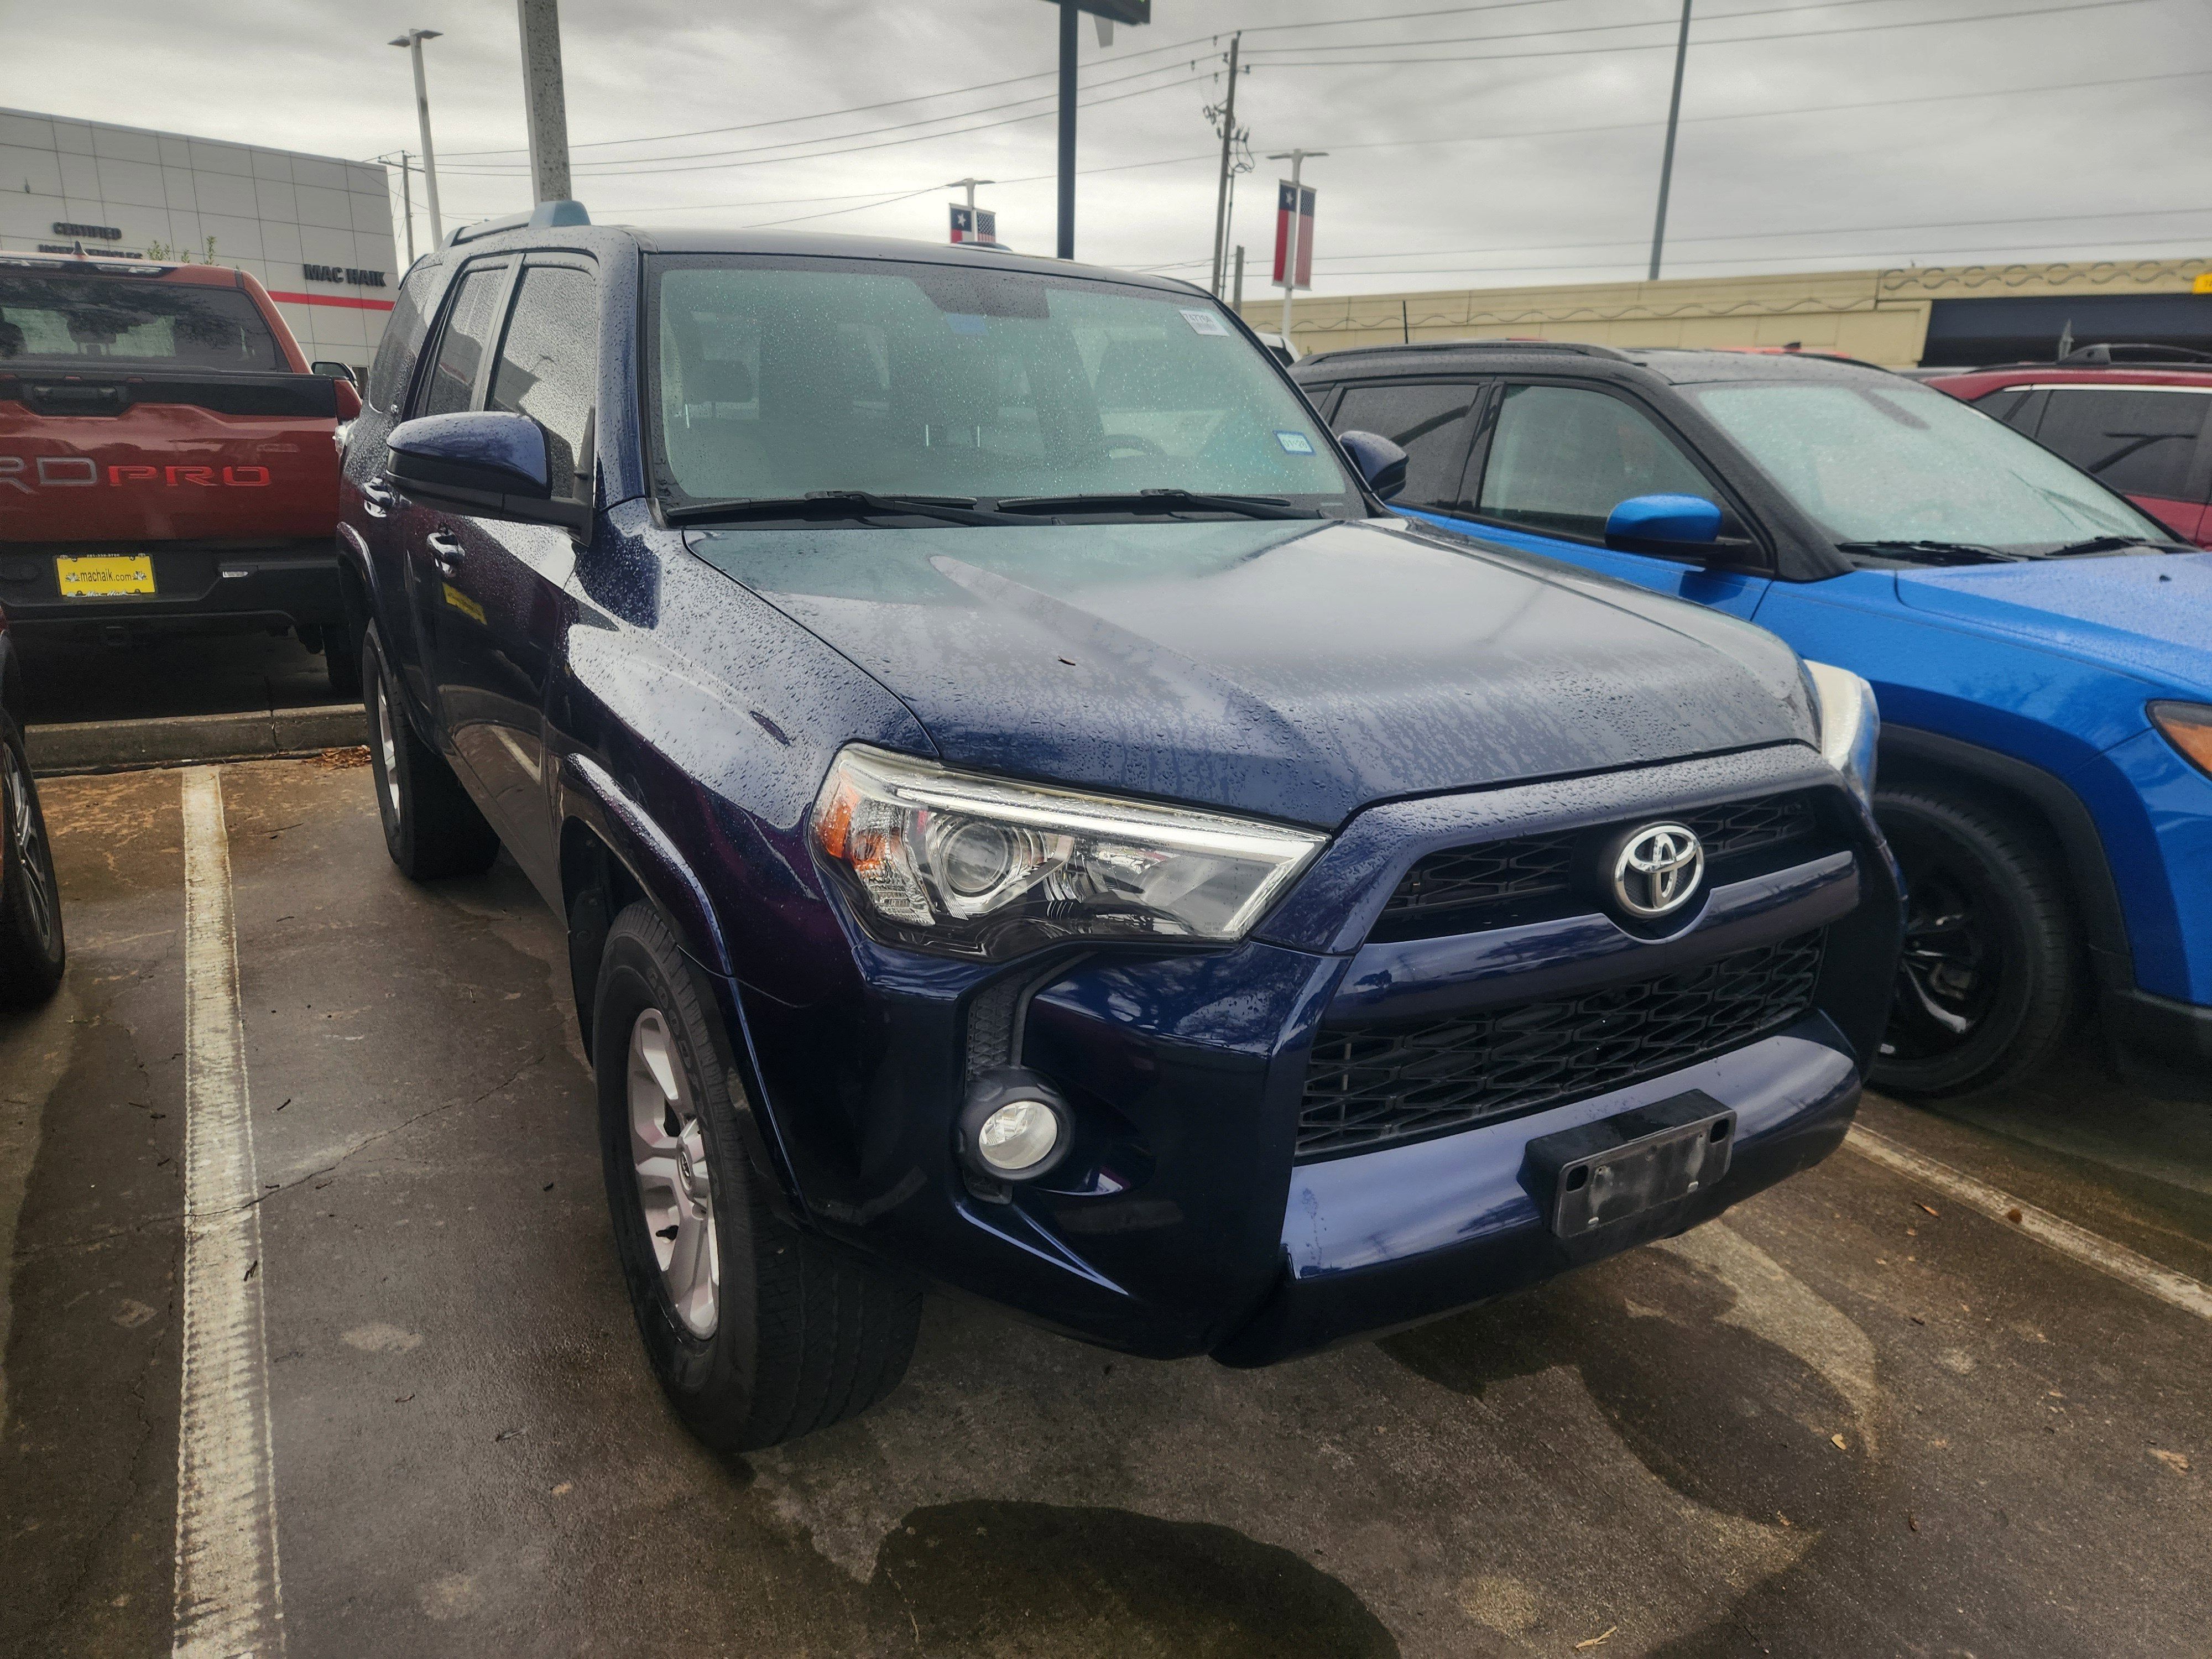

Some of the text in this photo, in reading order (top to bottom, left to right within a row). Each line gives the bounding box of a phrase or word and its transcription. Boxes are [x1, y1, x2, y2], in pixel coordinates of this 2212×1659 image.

[304, 264, 387, 287] MAC HAIK
[108, 465, 272, 487] PRO
[80, 568, 132, 582] machaik.com
